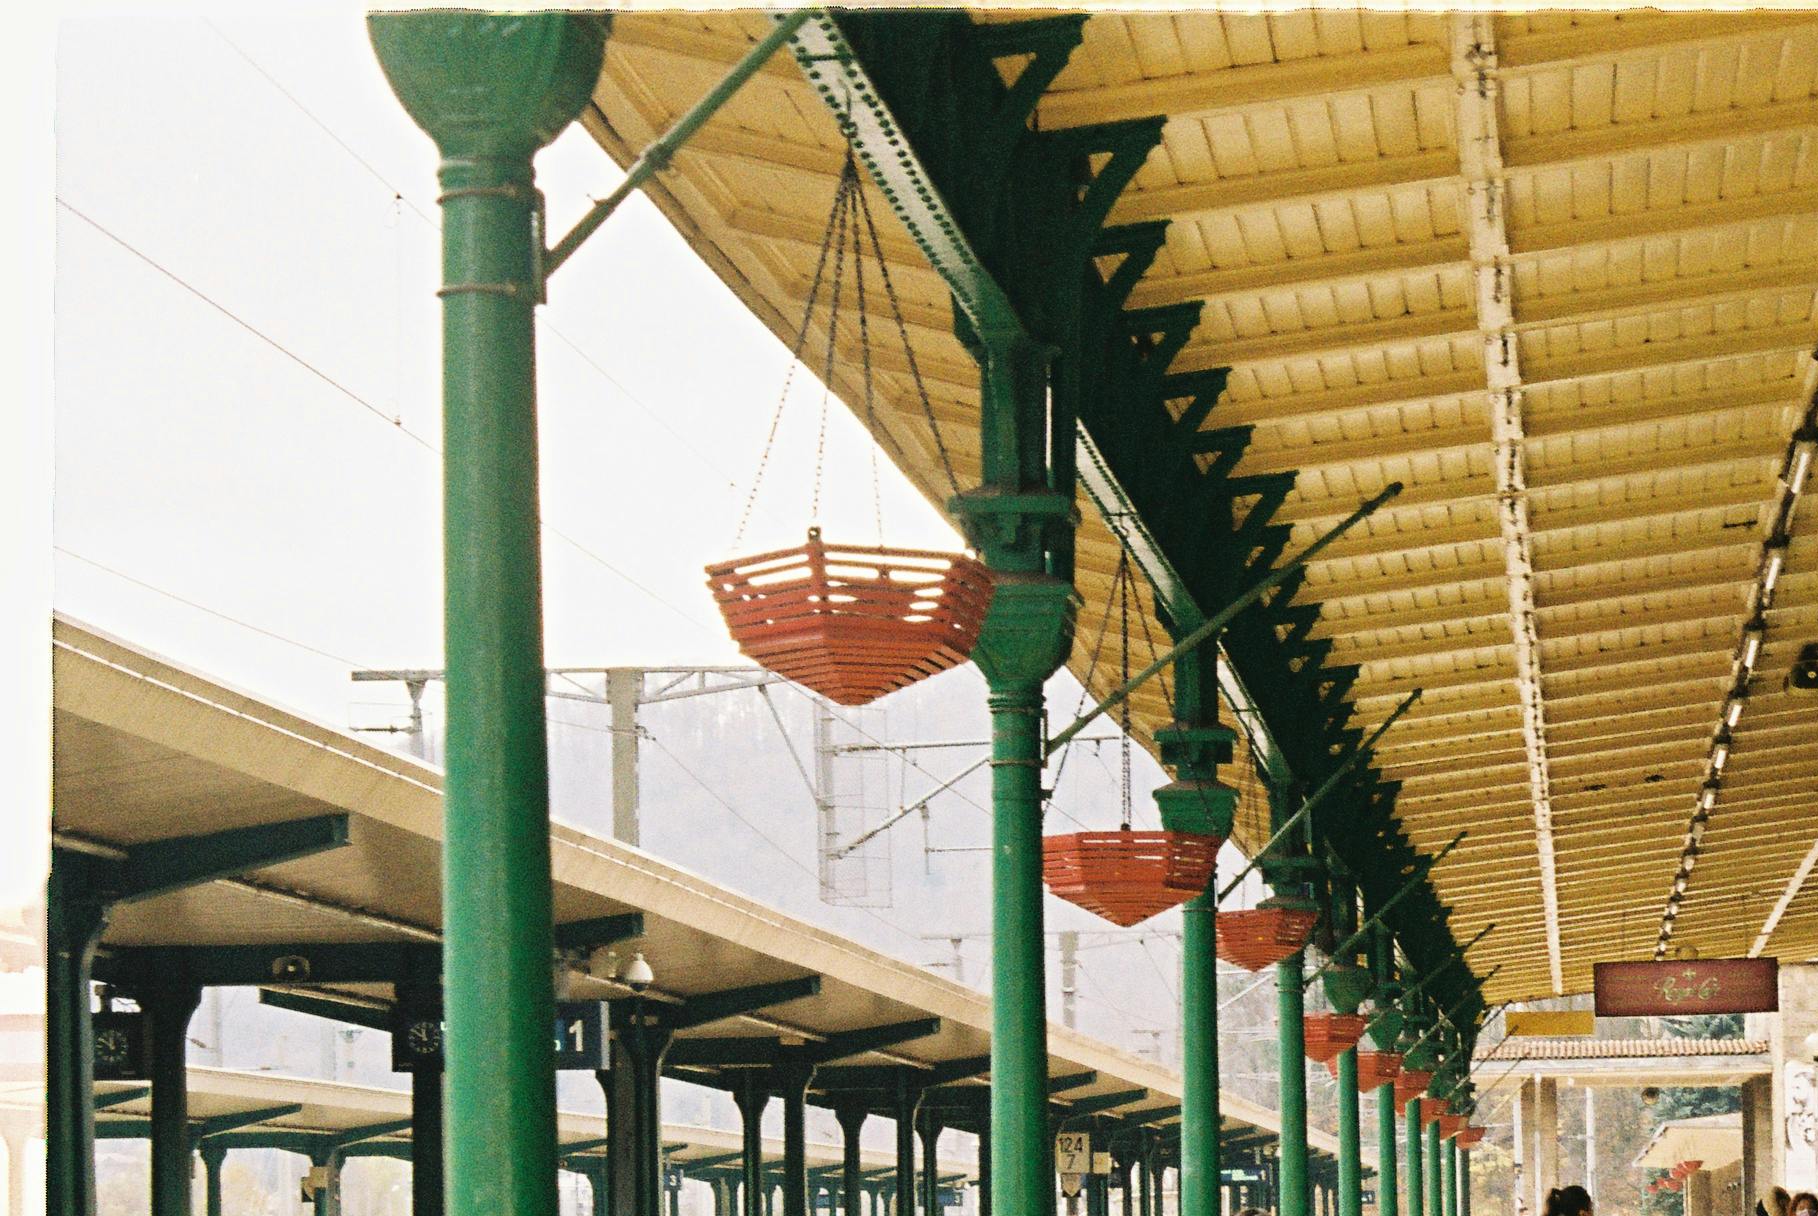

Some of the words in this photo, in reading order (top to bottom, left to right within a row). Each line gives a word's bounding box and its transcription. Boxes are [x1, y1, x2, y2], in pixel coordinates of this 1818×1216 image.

[568, 1019, 585, 1052] 1
[1058, 1136, 1084, 1154] 124
[1066, 1153, 1076, 1169] 7
